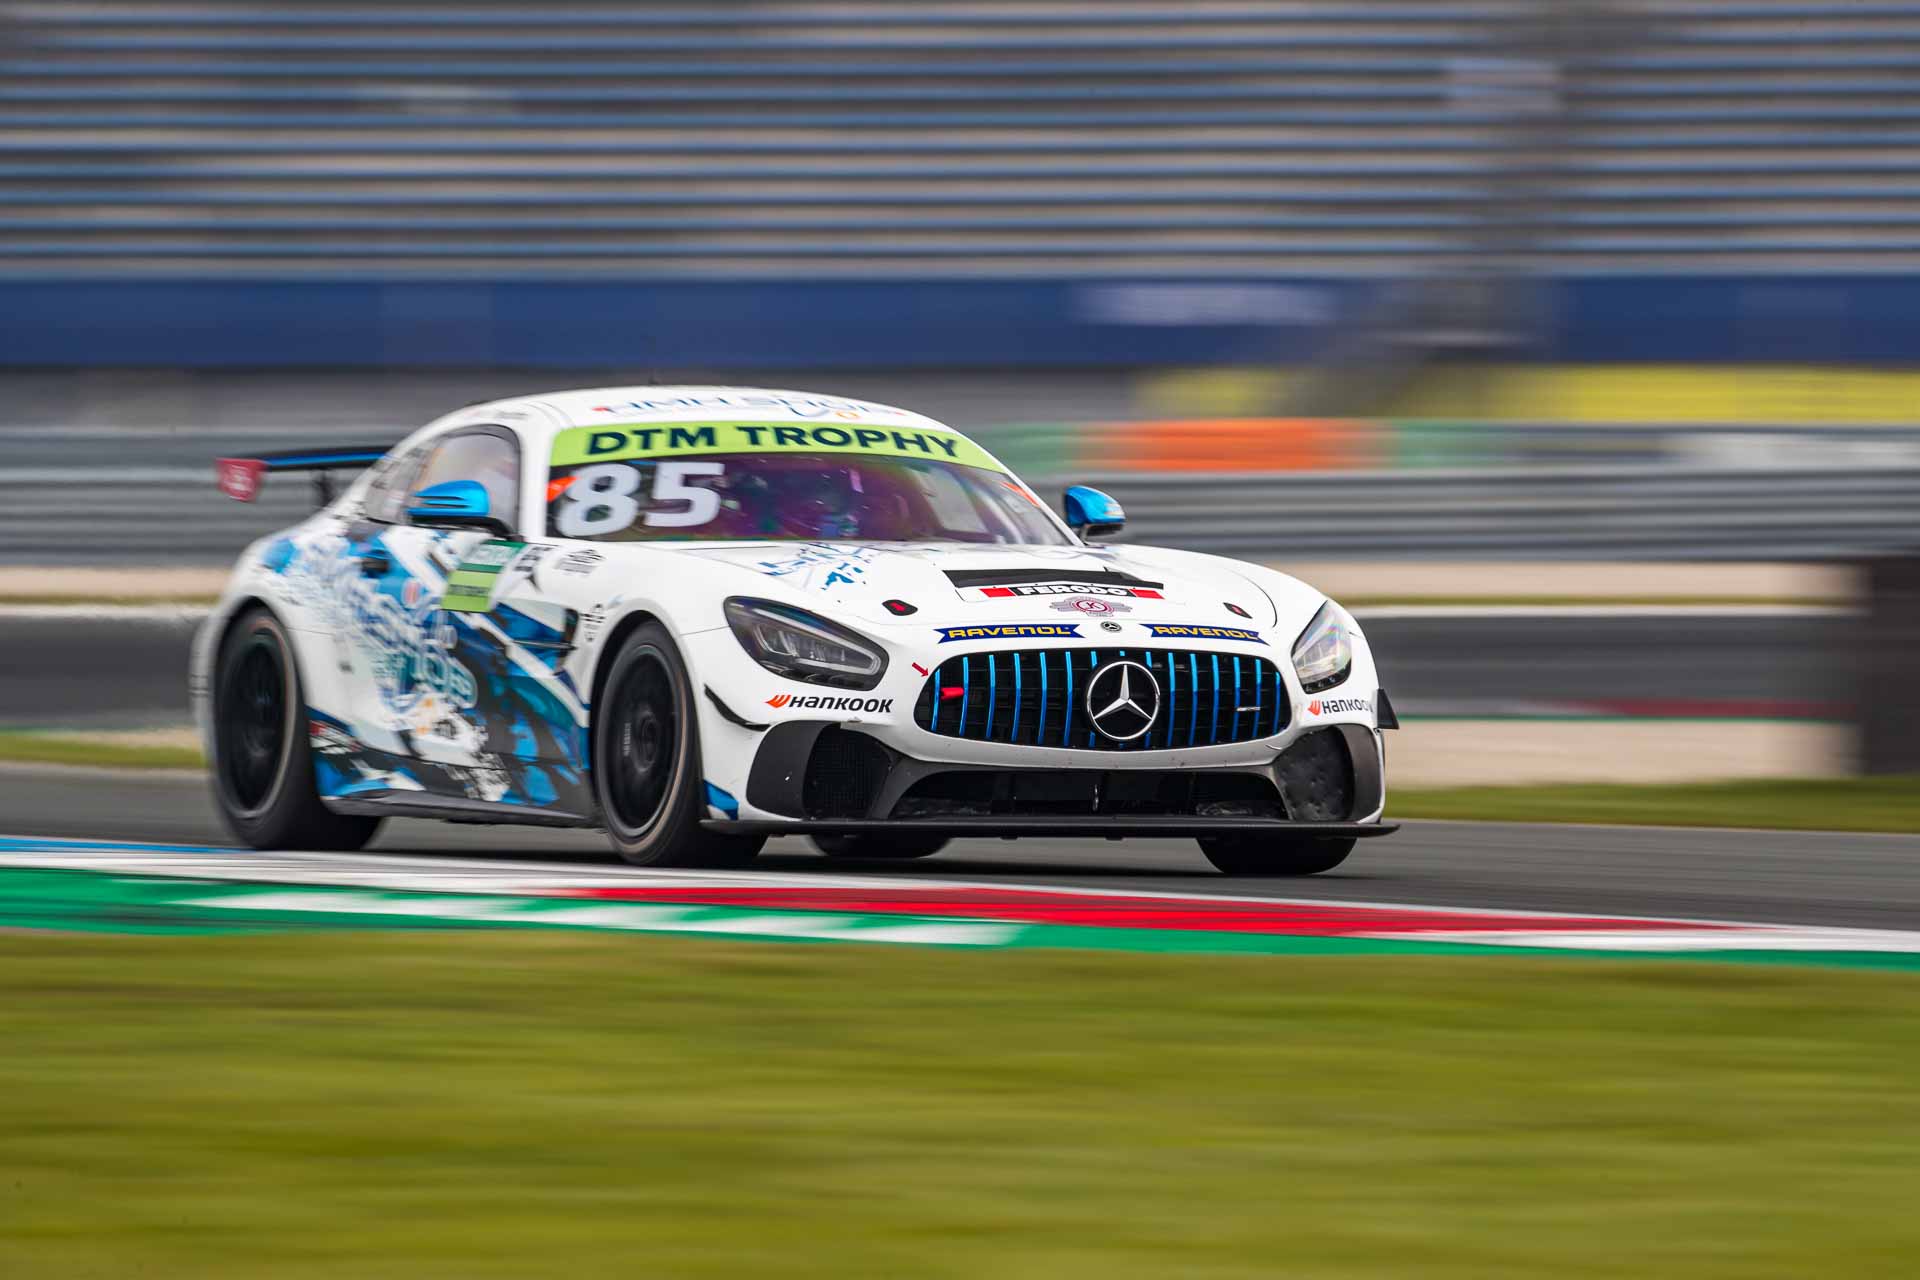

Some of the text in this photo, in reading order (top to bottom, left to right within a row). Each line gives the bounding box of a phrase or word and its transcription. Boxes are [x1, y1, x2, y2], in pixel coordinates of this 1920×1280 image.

[586, 426, 959, 457] DTM TROPHY
[556, 461, 725, 537] 85
[1017, 585, 1128, 597] FERODO
[947, 626, 1072, 639] RAVENOL
[1153, 626, 1259, 640] RAVENOL
